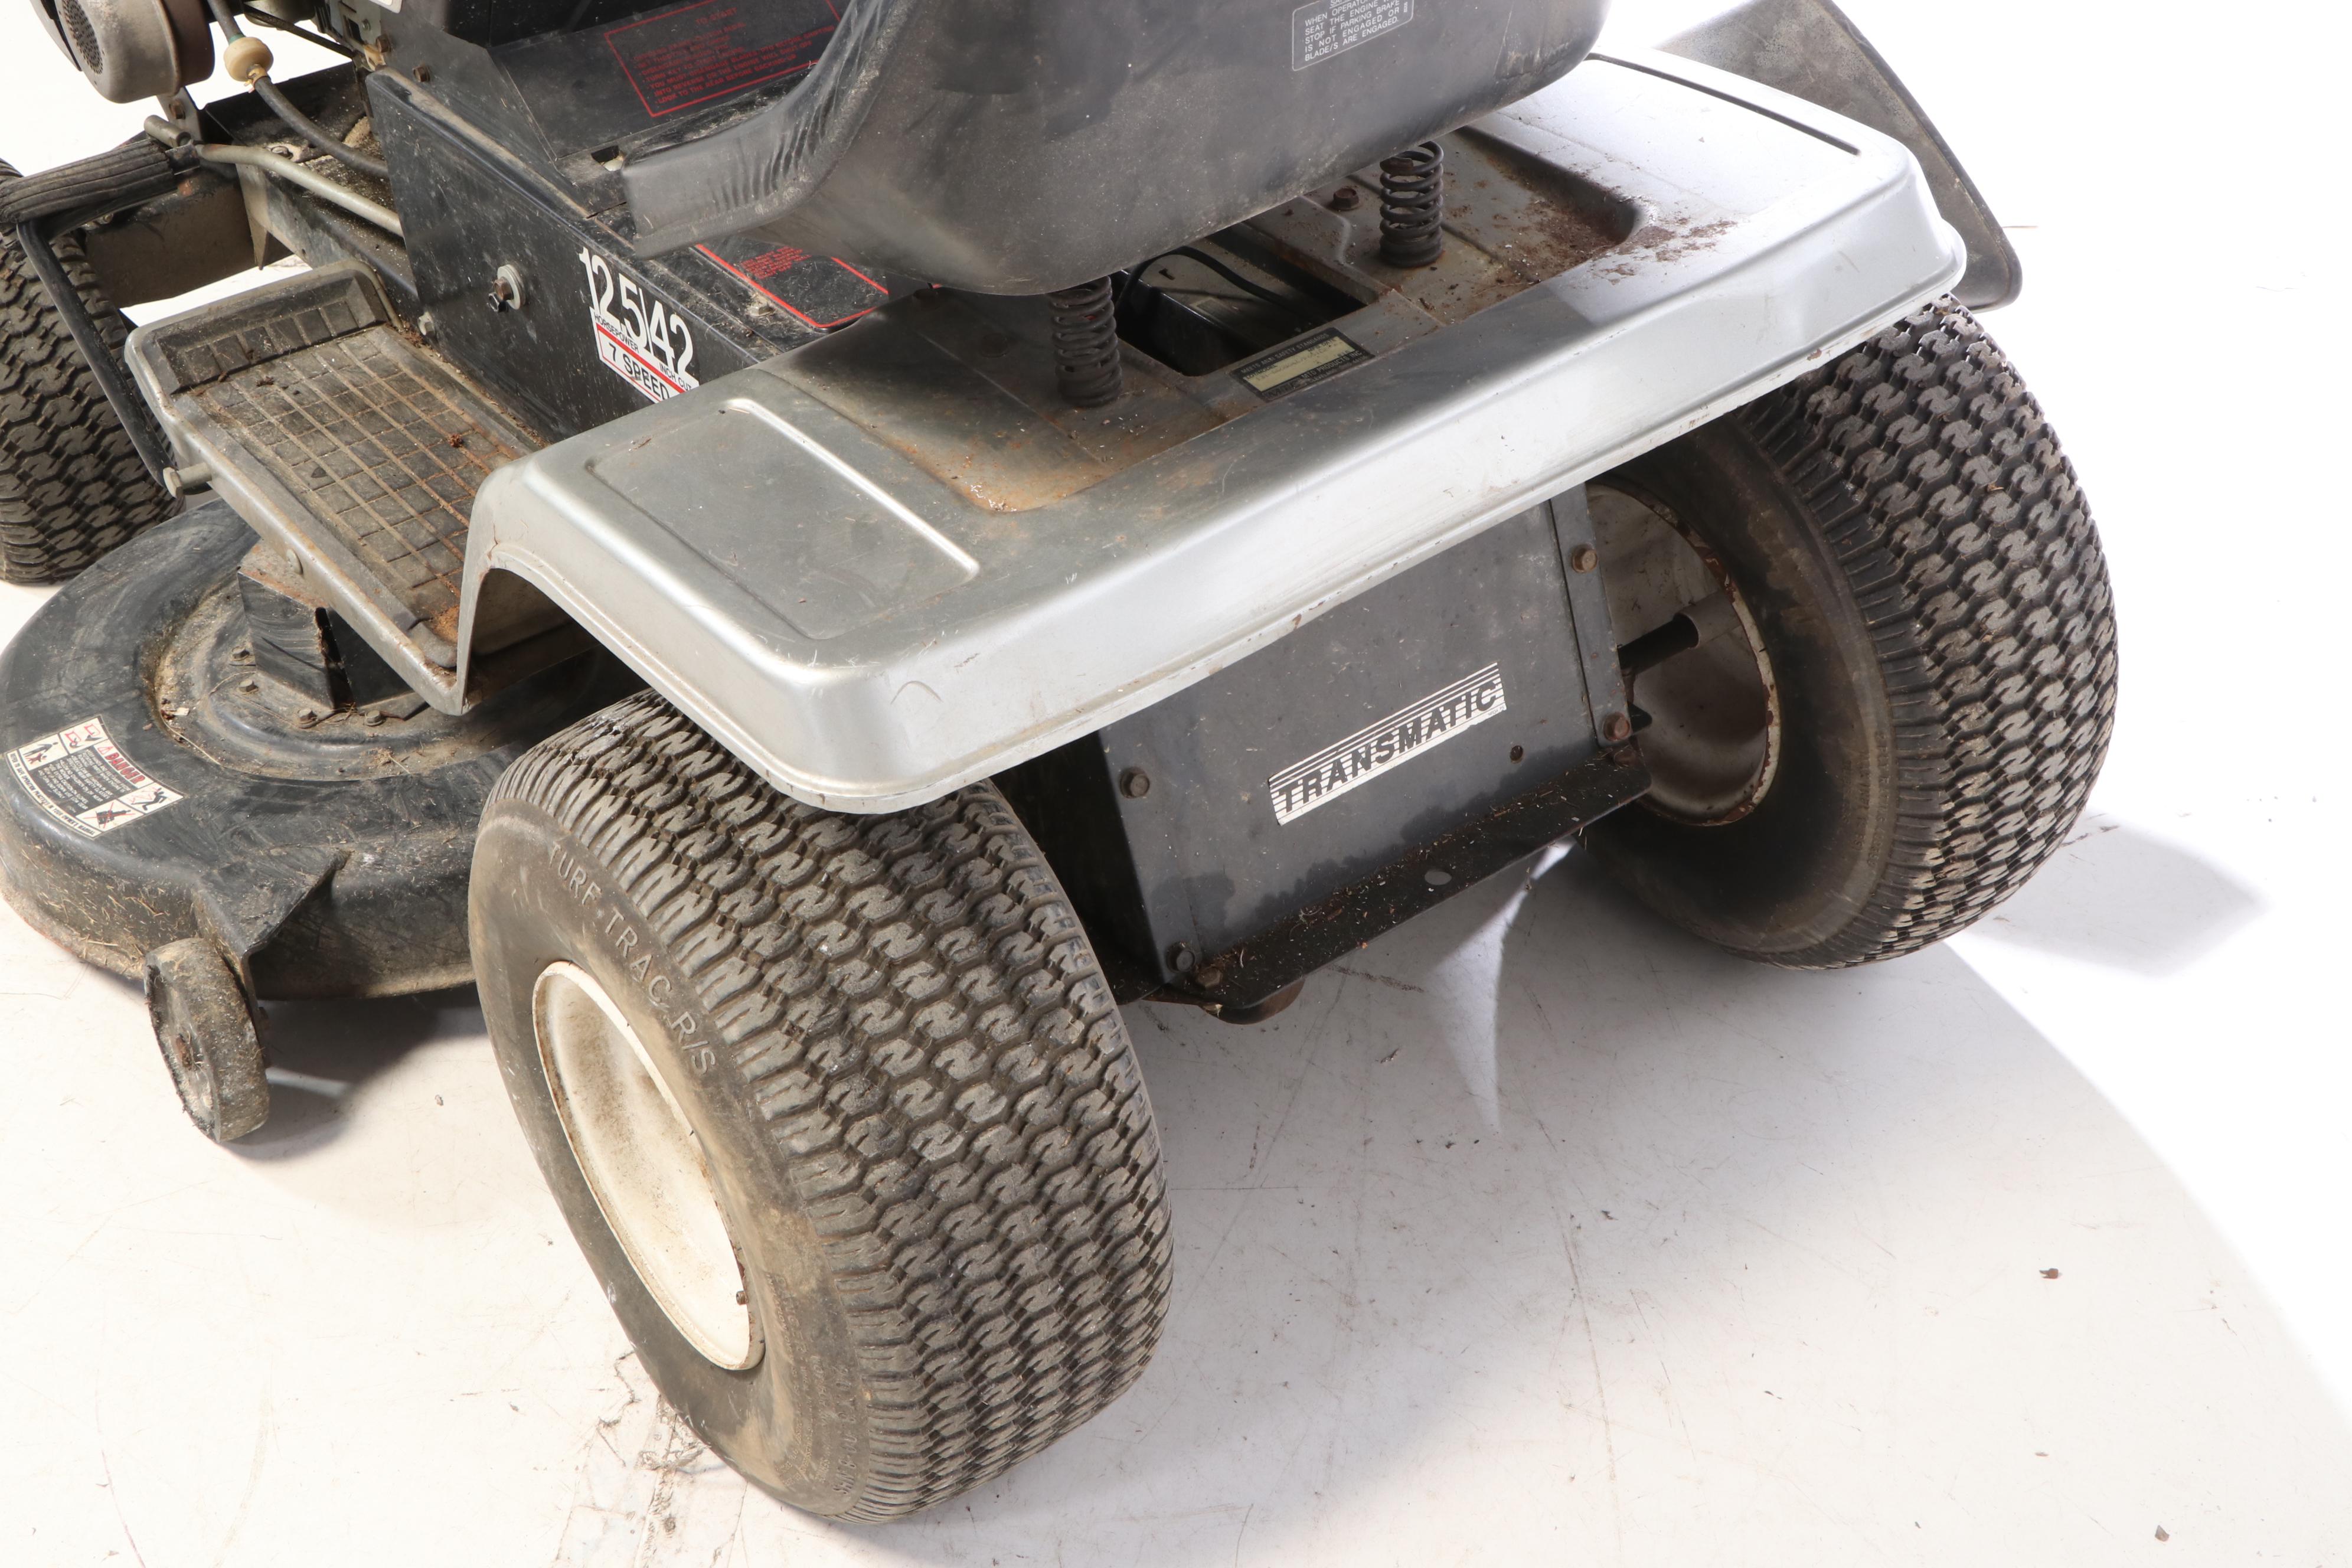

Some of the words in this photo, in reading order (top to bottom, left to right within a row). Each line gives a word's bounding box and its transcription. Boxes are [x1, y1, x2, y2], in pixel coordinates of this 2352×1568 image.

[695, 17, 708, 25] TO
[709, 7, 737, 21] START
[1305, 12, 1328, 27] WHEN
[1332, 0, 1367, 16] OPERATO
[1305, 22, 1325, 35] SEAT
[1329, 14, 1345, 25] THE
[1350, 0, 1378, 18] ENGINE
[1305, 31, 1325, 44] STOP
[1329, 26, 1337, 35] IF
[1341, 11, 1372, 30] PARKING
[1376, 0, 1400, 14] BRAKE
[1305, 44, 1313, 53] IS
[1319, 34, 1337, 48] NOT
[1342, 14, 1383, 37] ENGAGED
[1388, 6, 1400, 17] OR
[1305, 42, 1338, 61] BLADE/S
[1342, 33, 1358, 45] ARE
[1362, 16, 1399, 37] ENGAGED.
[594, 313, 640, 354] HORSEPOWER
[1240, 362, 1261, 374] MEETS
[1275, 346, 1296, 359] SAFETY
[1296, 332, 1329, 349] STANDARDS
[609, 342, 617, 362] 7
[623, 354, 669, 400] SPEED
[659, 362, 677, 383] INCH
[1301, 369, 1317, 379] MTD
[1316, 355, 1351, 373] PRODUCTS
[104, 752, 146, 784] DANGER
[1278, 681, 1498, 814] TRANSMATIC
[10, 753, 18, 763] REFER
[78, 825, 95, 835] MANUAL
[549, 844, 602, 906] TURF
[605, 906, 672, 1004] TRAC
[669, 1011, 716, 1074] R/S
